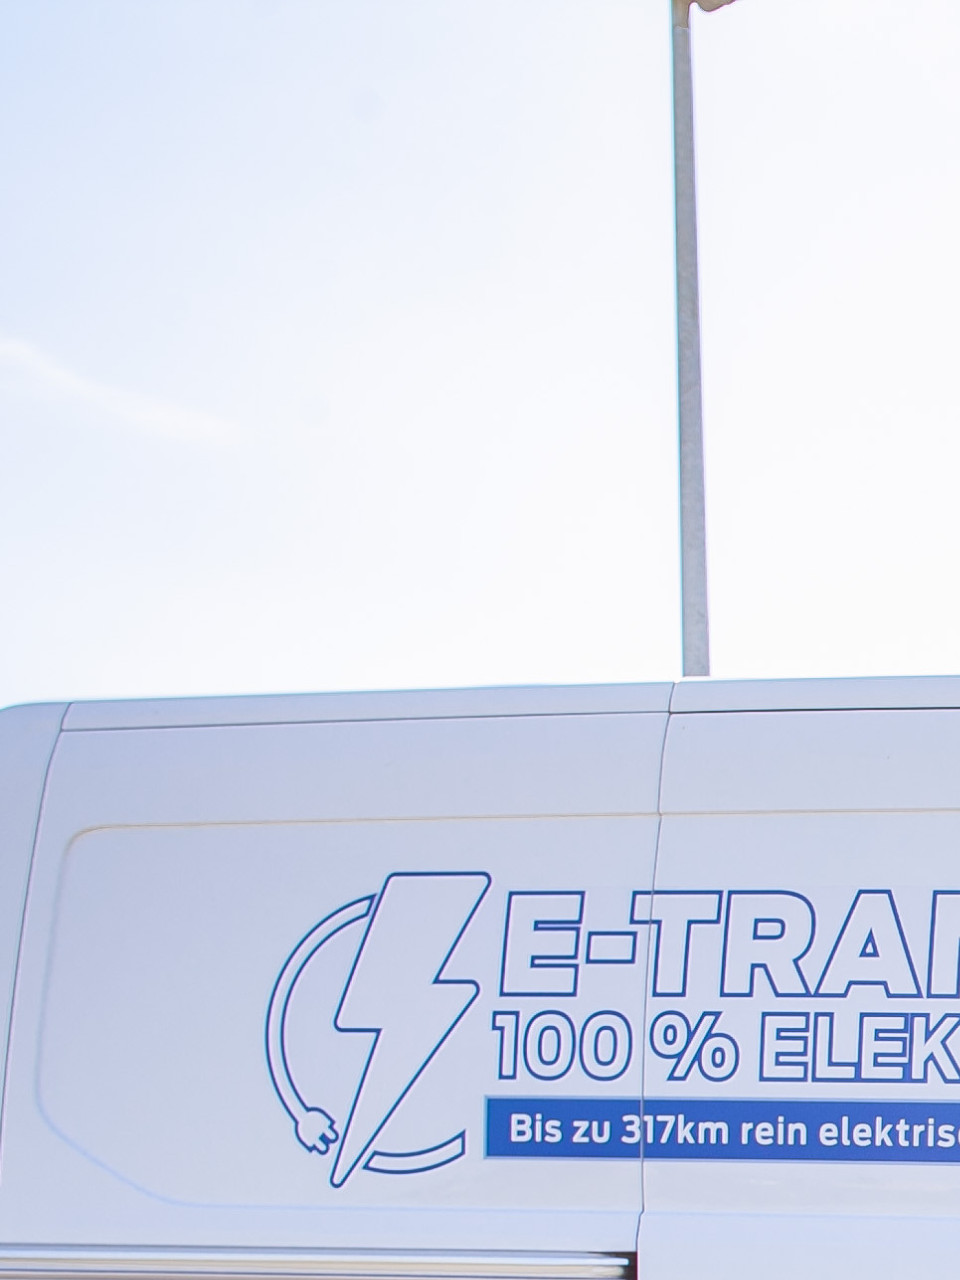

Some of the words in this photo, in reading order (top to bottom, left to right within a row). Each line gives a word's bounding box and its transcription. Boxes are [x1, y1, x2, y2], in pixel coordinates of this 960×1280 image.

[492, 1010, 633, 1081] 100
[650, 1010, 740, 1082] %
[510, 1113, 562, 1143] Bis
[572, 1120, 611, 1143] zu
[621, 1114, 729, 1145] 317km
[741, 1116, 806, 1146] rein
